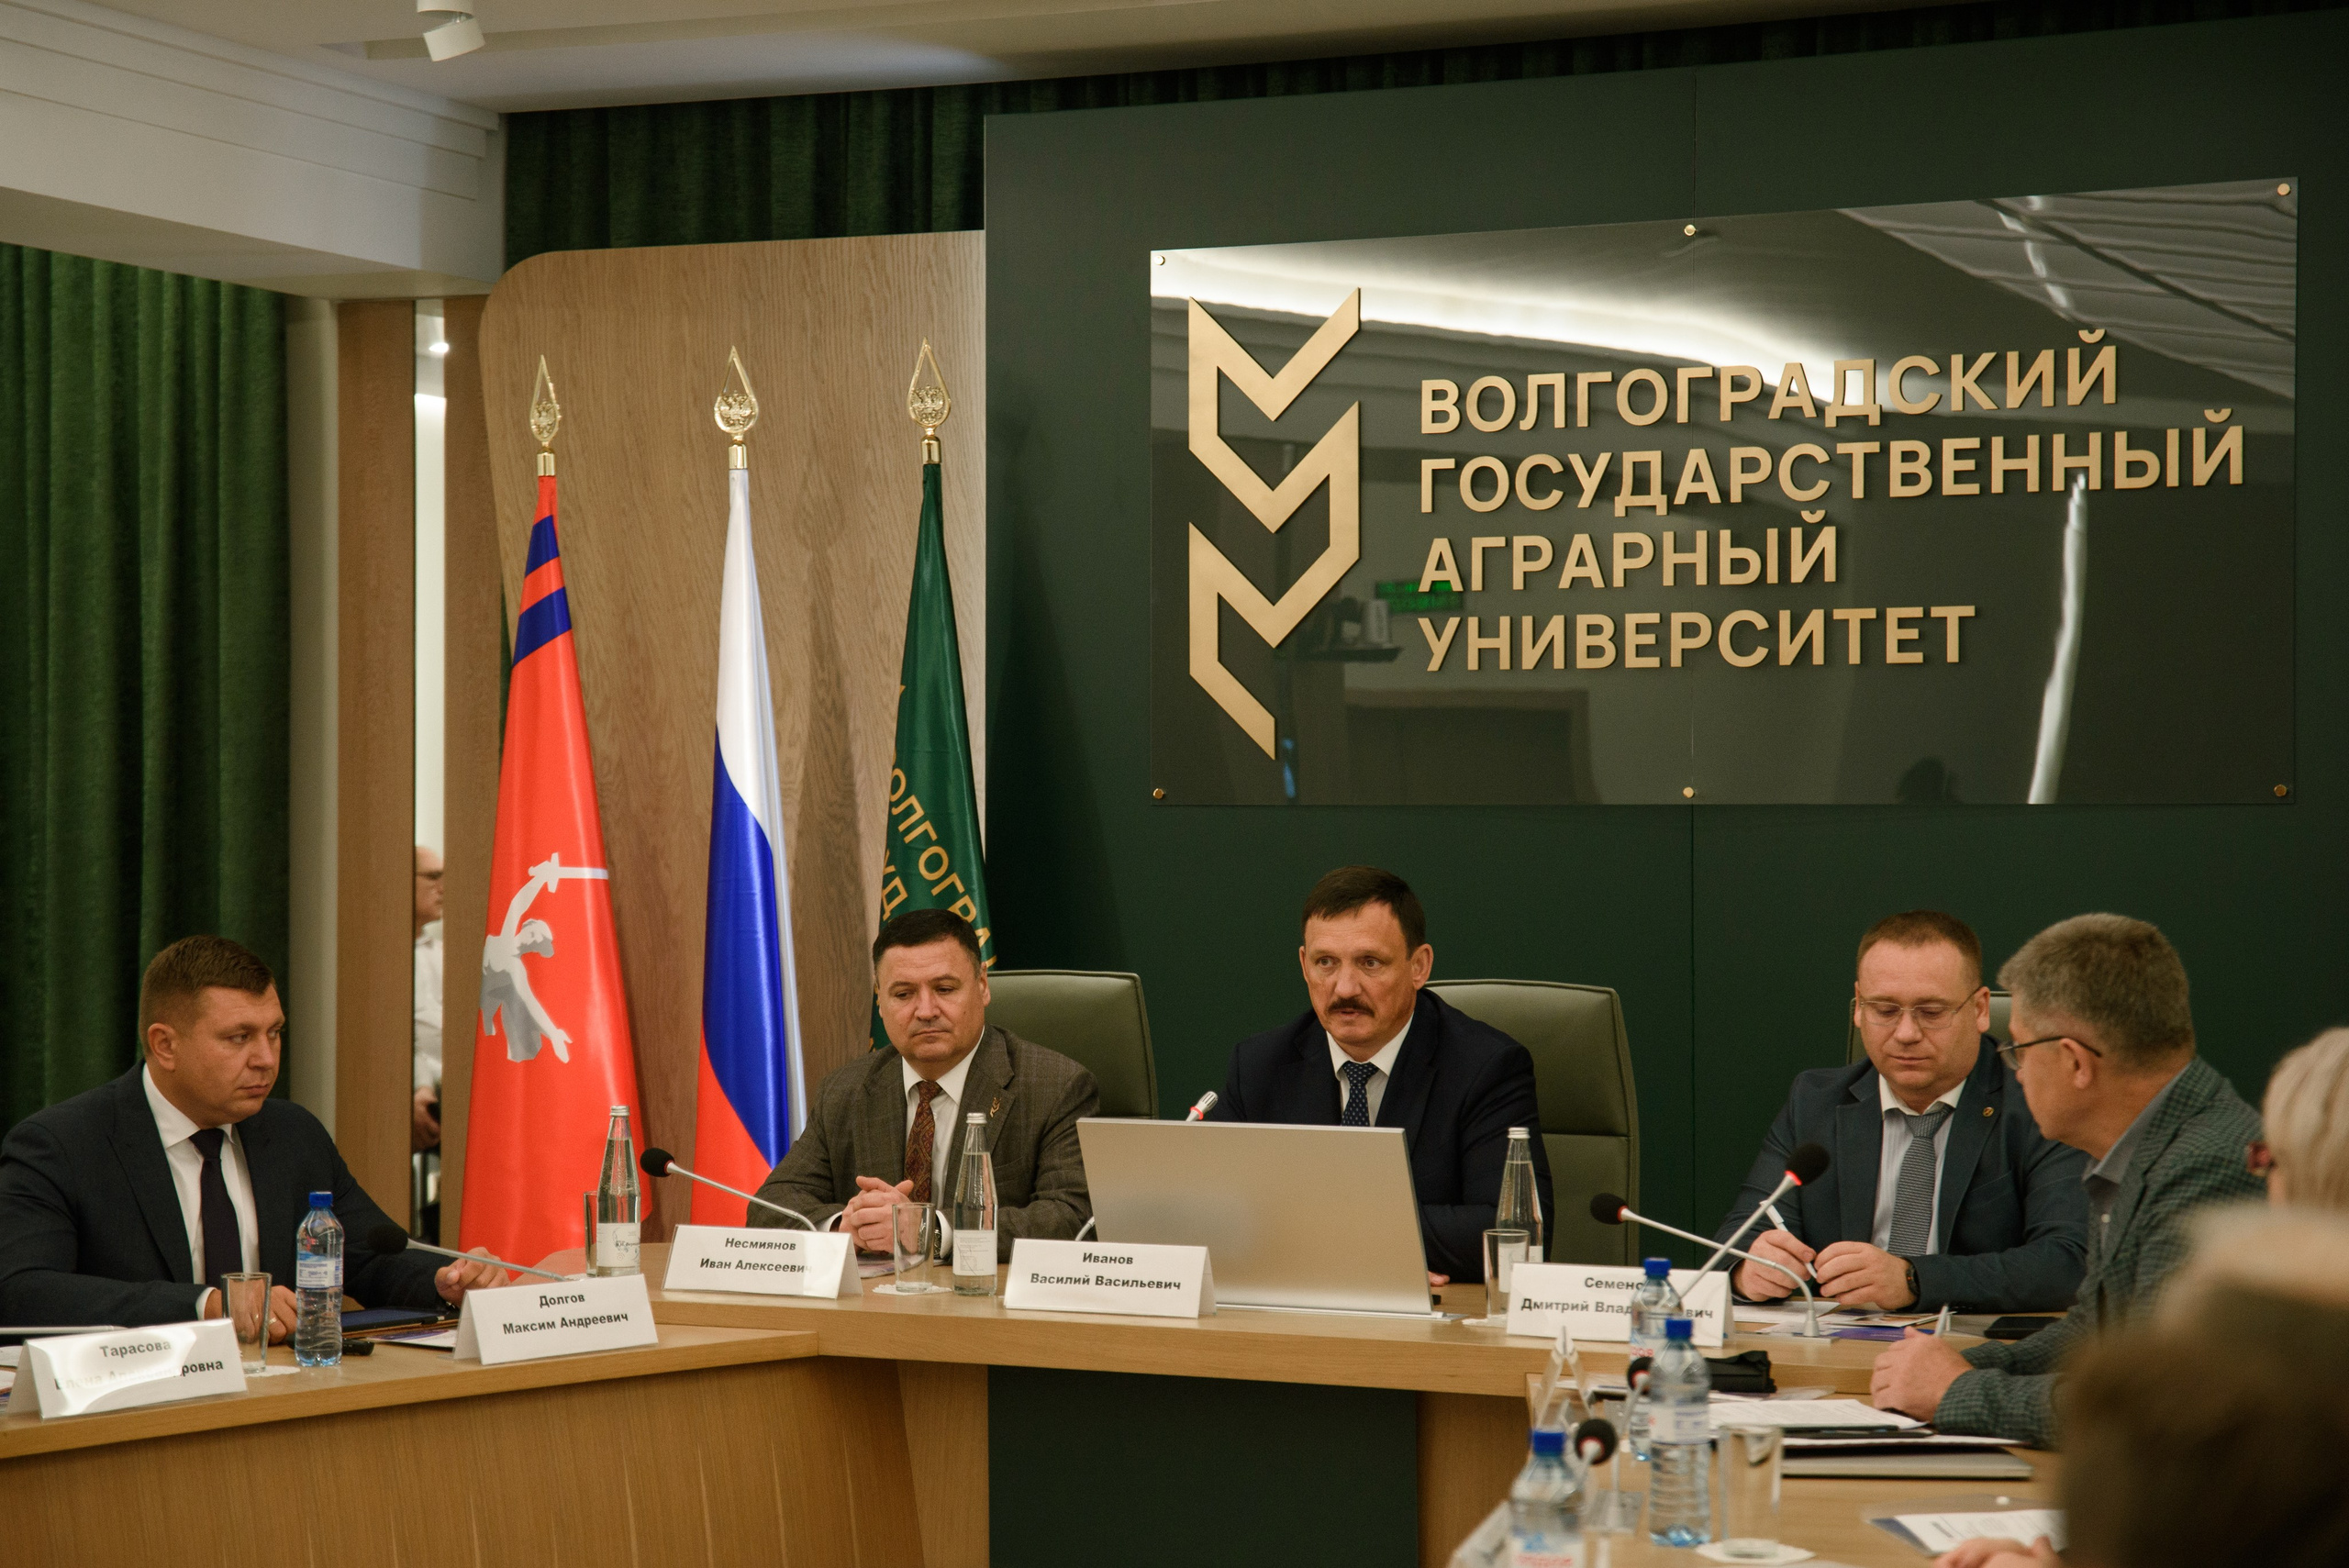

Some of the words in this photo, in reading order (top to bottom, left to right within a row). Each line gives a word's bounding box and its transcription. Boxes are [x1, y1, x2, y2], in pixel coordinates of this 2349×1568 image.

[1421, 328, 2117, 434] ВОЛГОГРАДСКИЙ
[1420, 408, 2243, 517] ГОСУДАРСТВЕННЫЙ
[1418, 509, 1837, 593] АГРАРНЫЙ
[1418, 605, 1976, 672] УНИВЕРСИТЕТ
[725, 1238, 796, 1251] Несмиянов
[699, 1258, 731, 1270] Иван
[735, 1260, 812, 1273] Алексеевич
[1082, 1252, 1134, 1265] Иванов
[1030, 1273, 1090, 1285] Василий
[1095, 1275, 1181, 1290] Васильевич
[1585, 1276, 1644, 1291] Семено
[540, 1295, 585, 1308] Долгов
[1521, 1297, 1589, 1314] Дмитрий
[1595, 1301, 1713, 1318] Владвич
[503, 1319, 556, 1335] Максим
[560, 1313, 629, 1329] Андреевич
[100, 1340, 172, 1358] Тарасова
